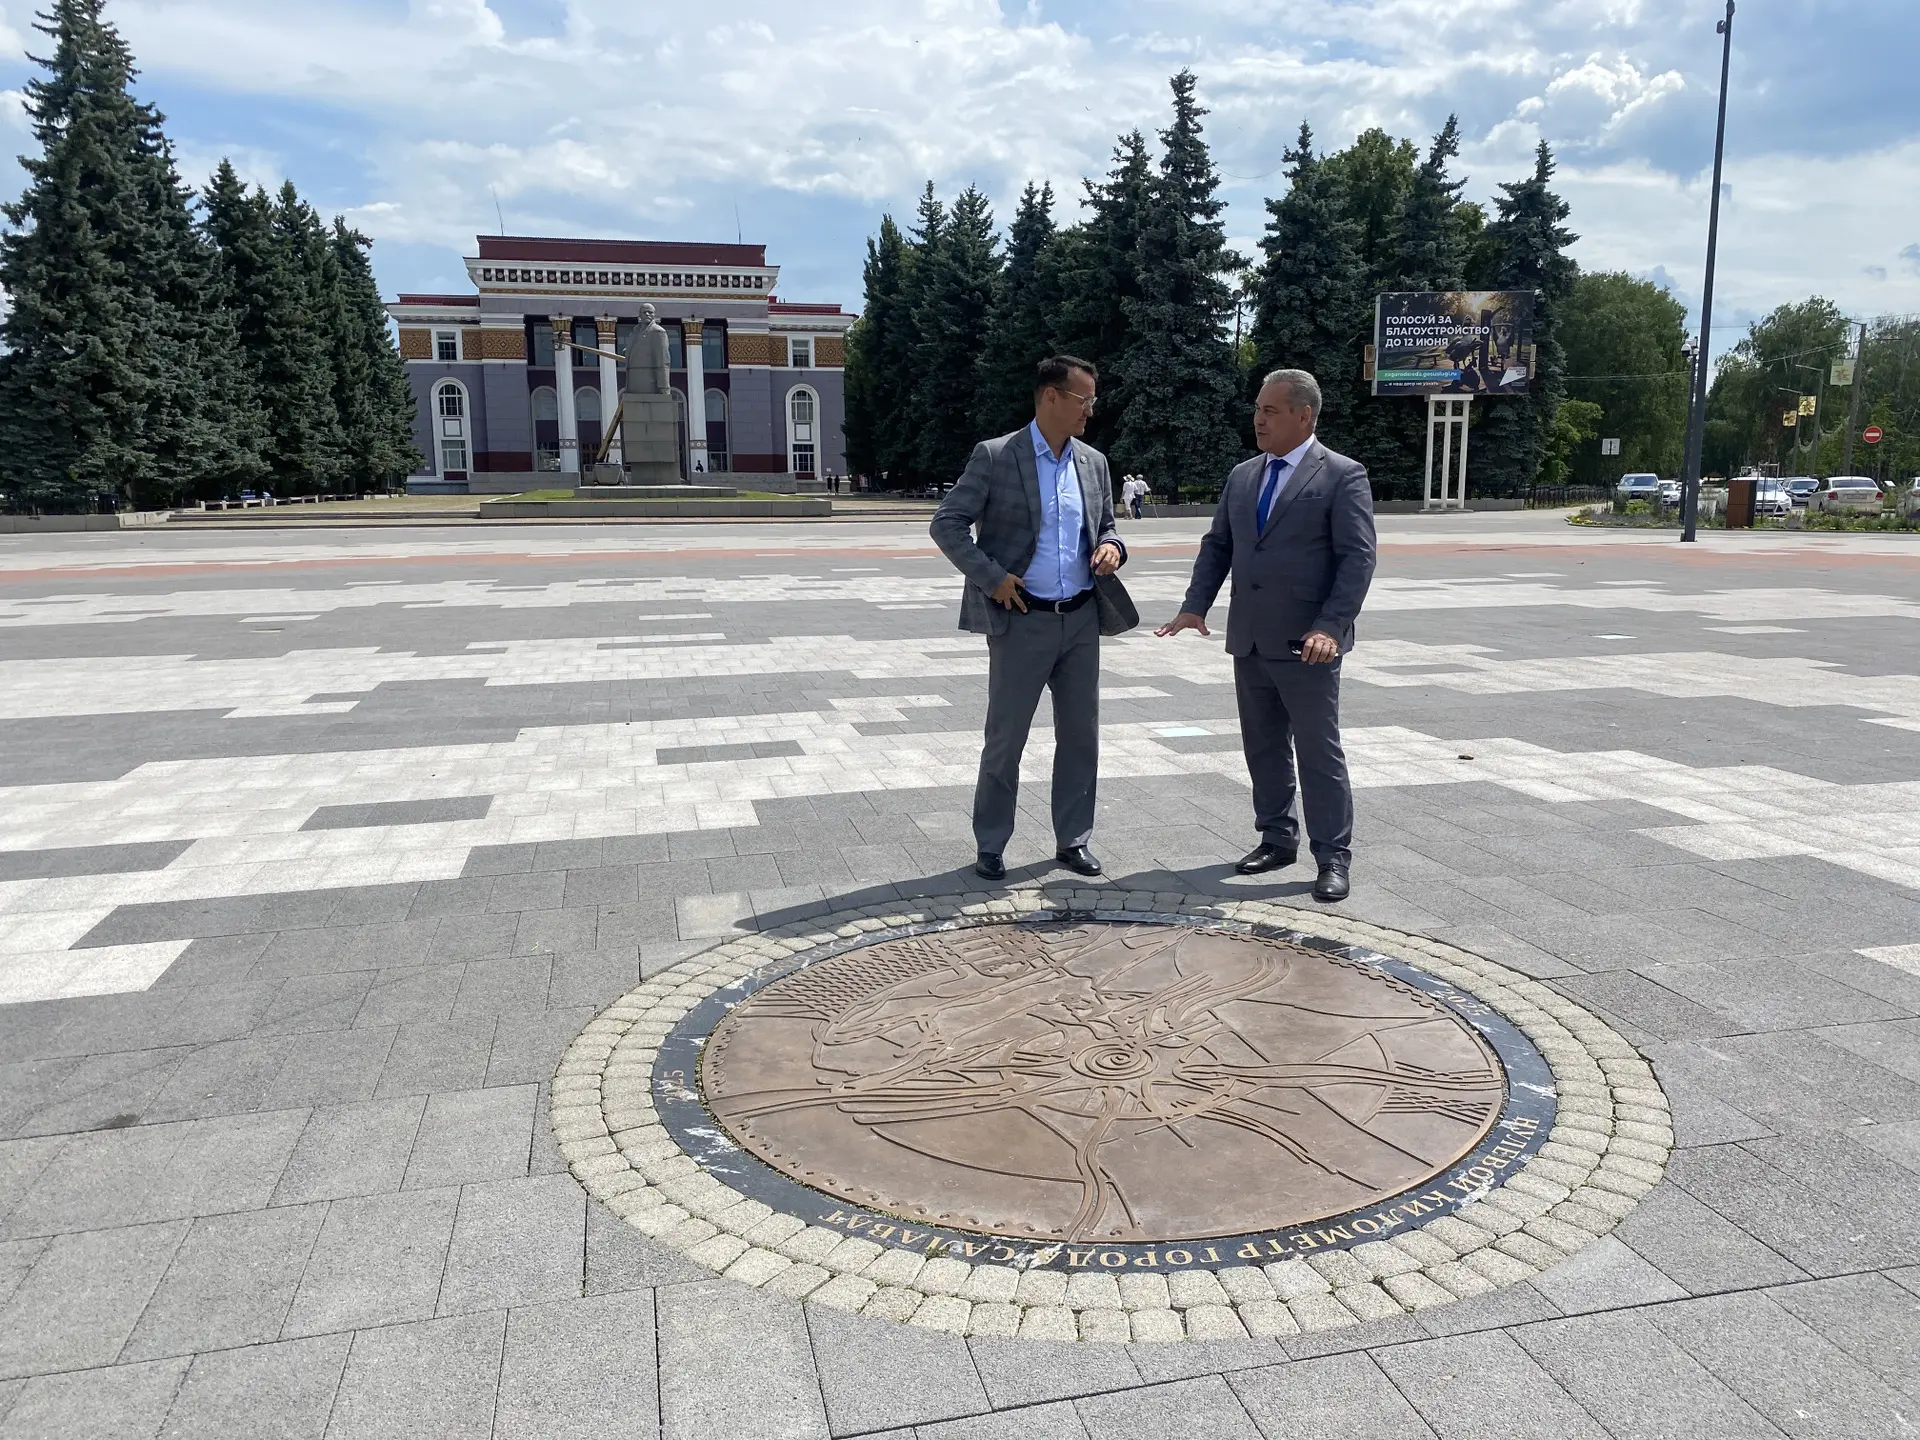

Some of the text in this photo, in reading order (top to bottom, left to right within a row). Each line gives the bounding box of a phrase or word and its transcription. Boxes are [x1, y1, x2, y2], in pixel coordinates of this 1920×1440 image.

[1386, 314, 1435, 324] ГОЛОСУЙ
[1386, 325, 1489, 335] БЛАГОУСТРОЙСТВО
[1385, 339, 1401, 348] ДО
[1416, 338, 1448, 346] ИЮНЯ
[1435, 988, 1492, 1016] 2025
[816, 1115, 1540, 1267] НУЛЕВОЙ КИЛОМЕТР ГОРОДА САЛАВАТ
